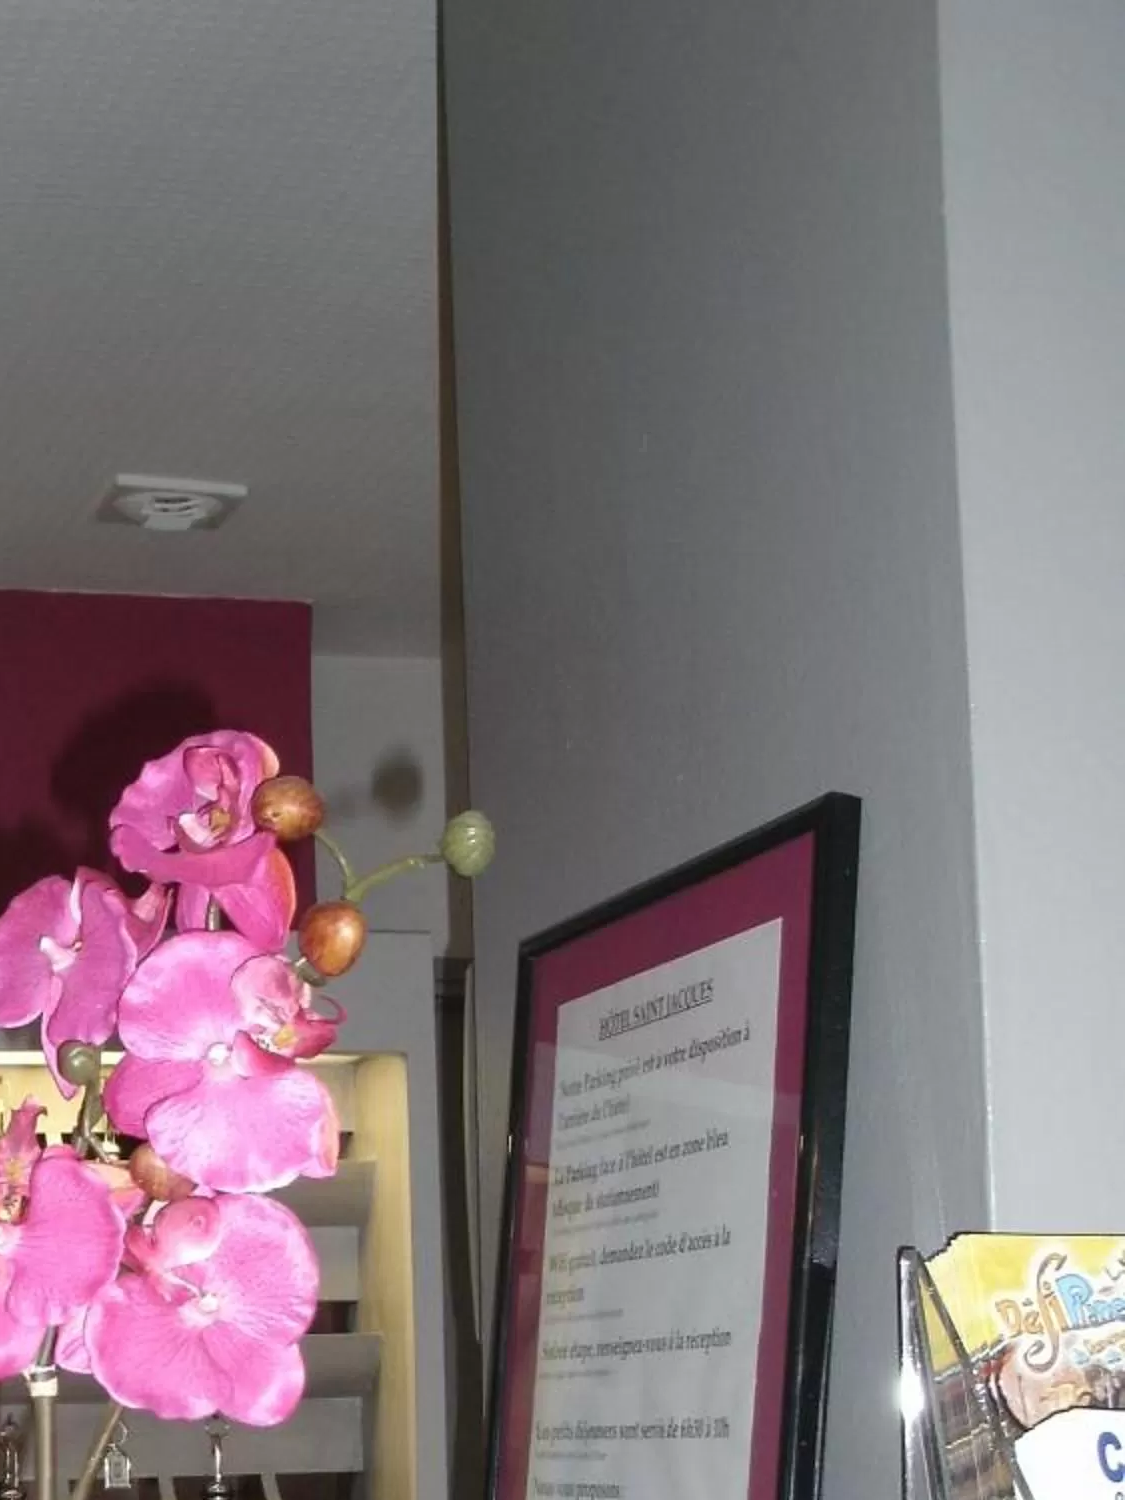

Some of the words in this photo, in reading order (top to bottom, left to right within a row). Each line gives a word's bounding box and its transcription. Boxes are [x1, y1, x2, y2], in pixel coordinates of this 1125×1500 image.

[633, 995, 664, 1026] SAINT
[666, 977, 714, 1014] JACQUES
[688, 1026, 743, 1063] disposition
